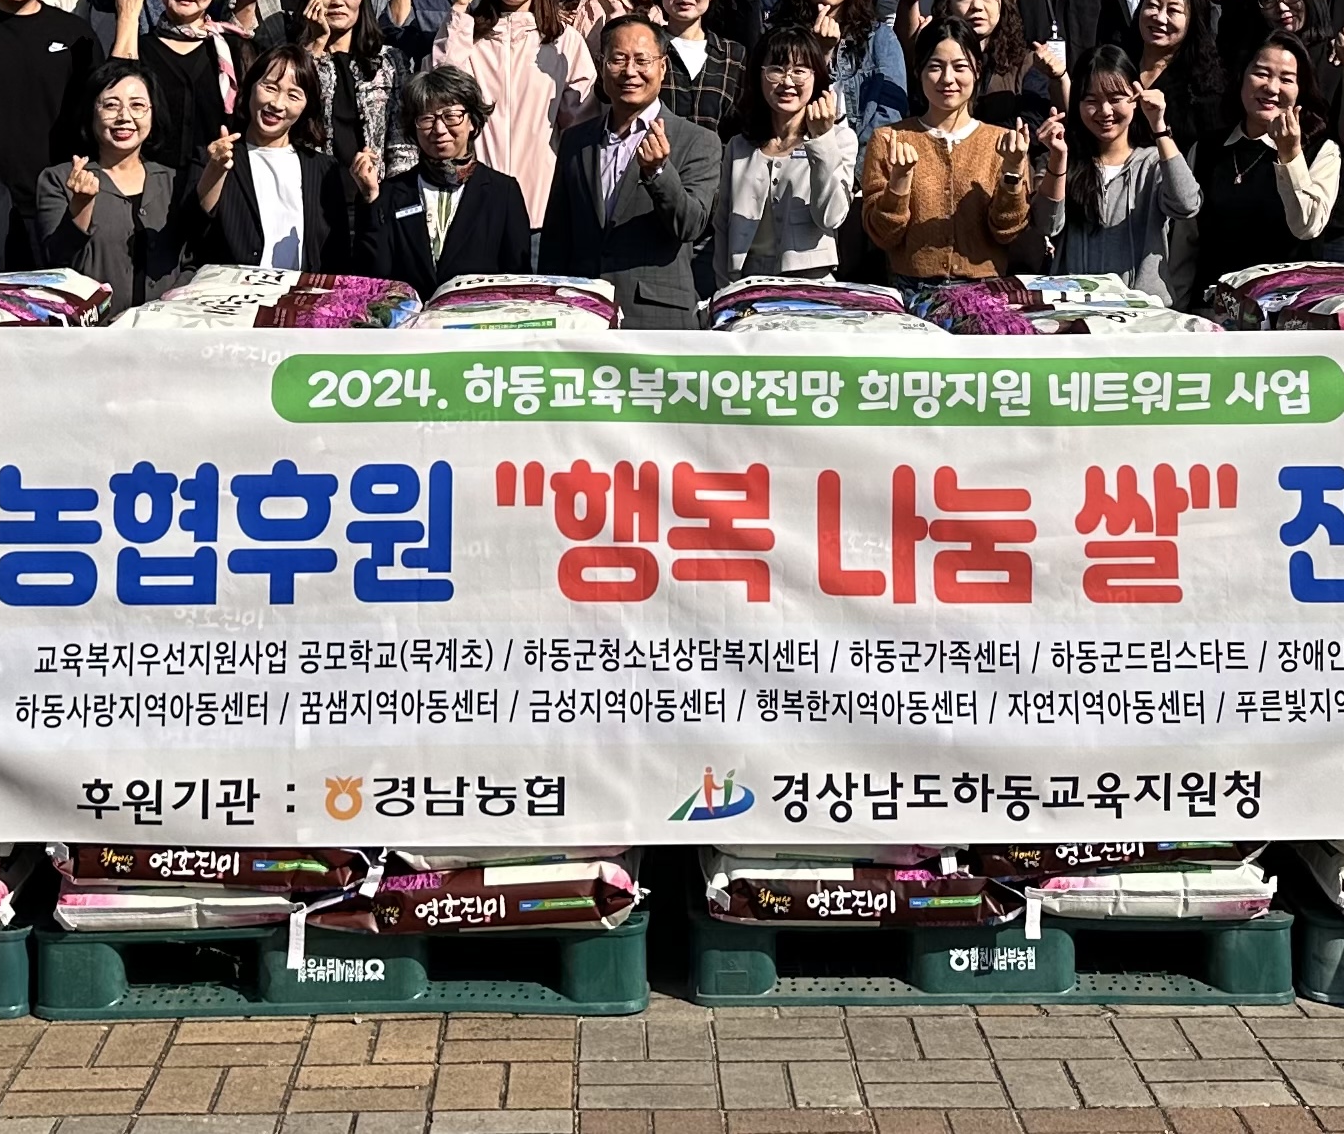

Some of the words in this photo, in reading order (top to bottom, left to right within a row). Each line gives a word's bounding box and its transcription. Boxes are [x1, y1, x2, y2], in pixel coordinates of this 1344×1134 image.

[308, 368, 448, 409] 2024.
[463, 363, 845, 418] 하동교육복지안전망
[858, 369, 1031, 418] 희망지원
[1048, 371, 1211, 415] 네트워크
[1225, 370, 1310, 415] 사업
[496, 460, 774, 602] "행복
[818, 465, 1036, 603] 나눔
[1076, 464, 1237, 603] 쌀"
[35, 641, 286, 677] 교육복지우선지원사업
[299, 638, 492, 673] 공모학교(묵계초)
[524, 638, 818, 673] 하동군청소년상담복지센터
[850, 639, 1019, 674] 하동군가족센터
[1051, 640, 1248, 674] 하동군드림스타트
[16, 692, 267, 728] 하동사랑지역아동센터
[300, 689, 497, 724] 꿈샘지역아동센터
[530, 689, 724, 723] 금성지역아동센터
[757, 689, 977, 724] 행복한지역아동센터
[1009, 690, 1204, 724] 자연지역아동센터
[77, 779, 260, 825] 후원기관
[374, 776, 564, 816] 경남농협
[772, 771, 1260, 822] 경상남도하동교육지원청
[149, 849, 239, 879] 영호진미
[414, 893, 506, 926] 영호진미
[807, 885, 896, 917] 영호진미
